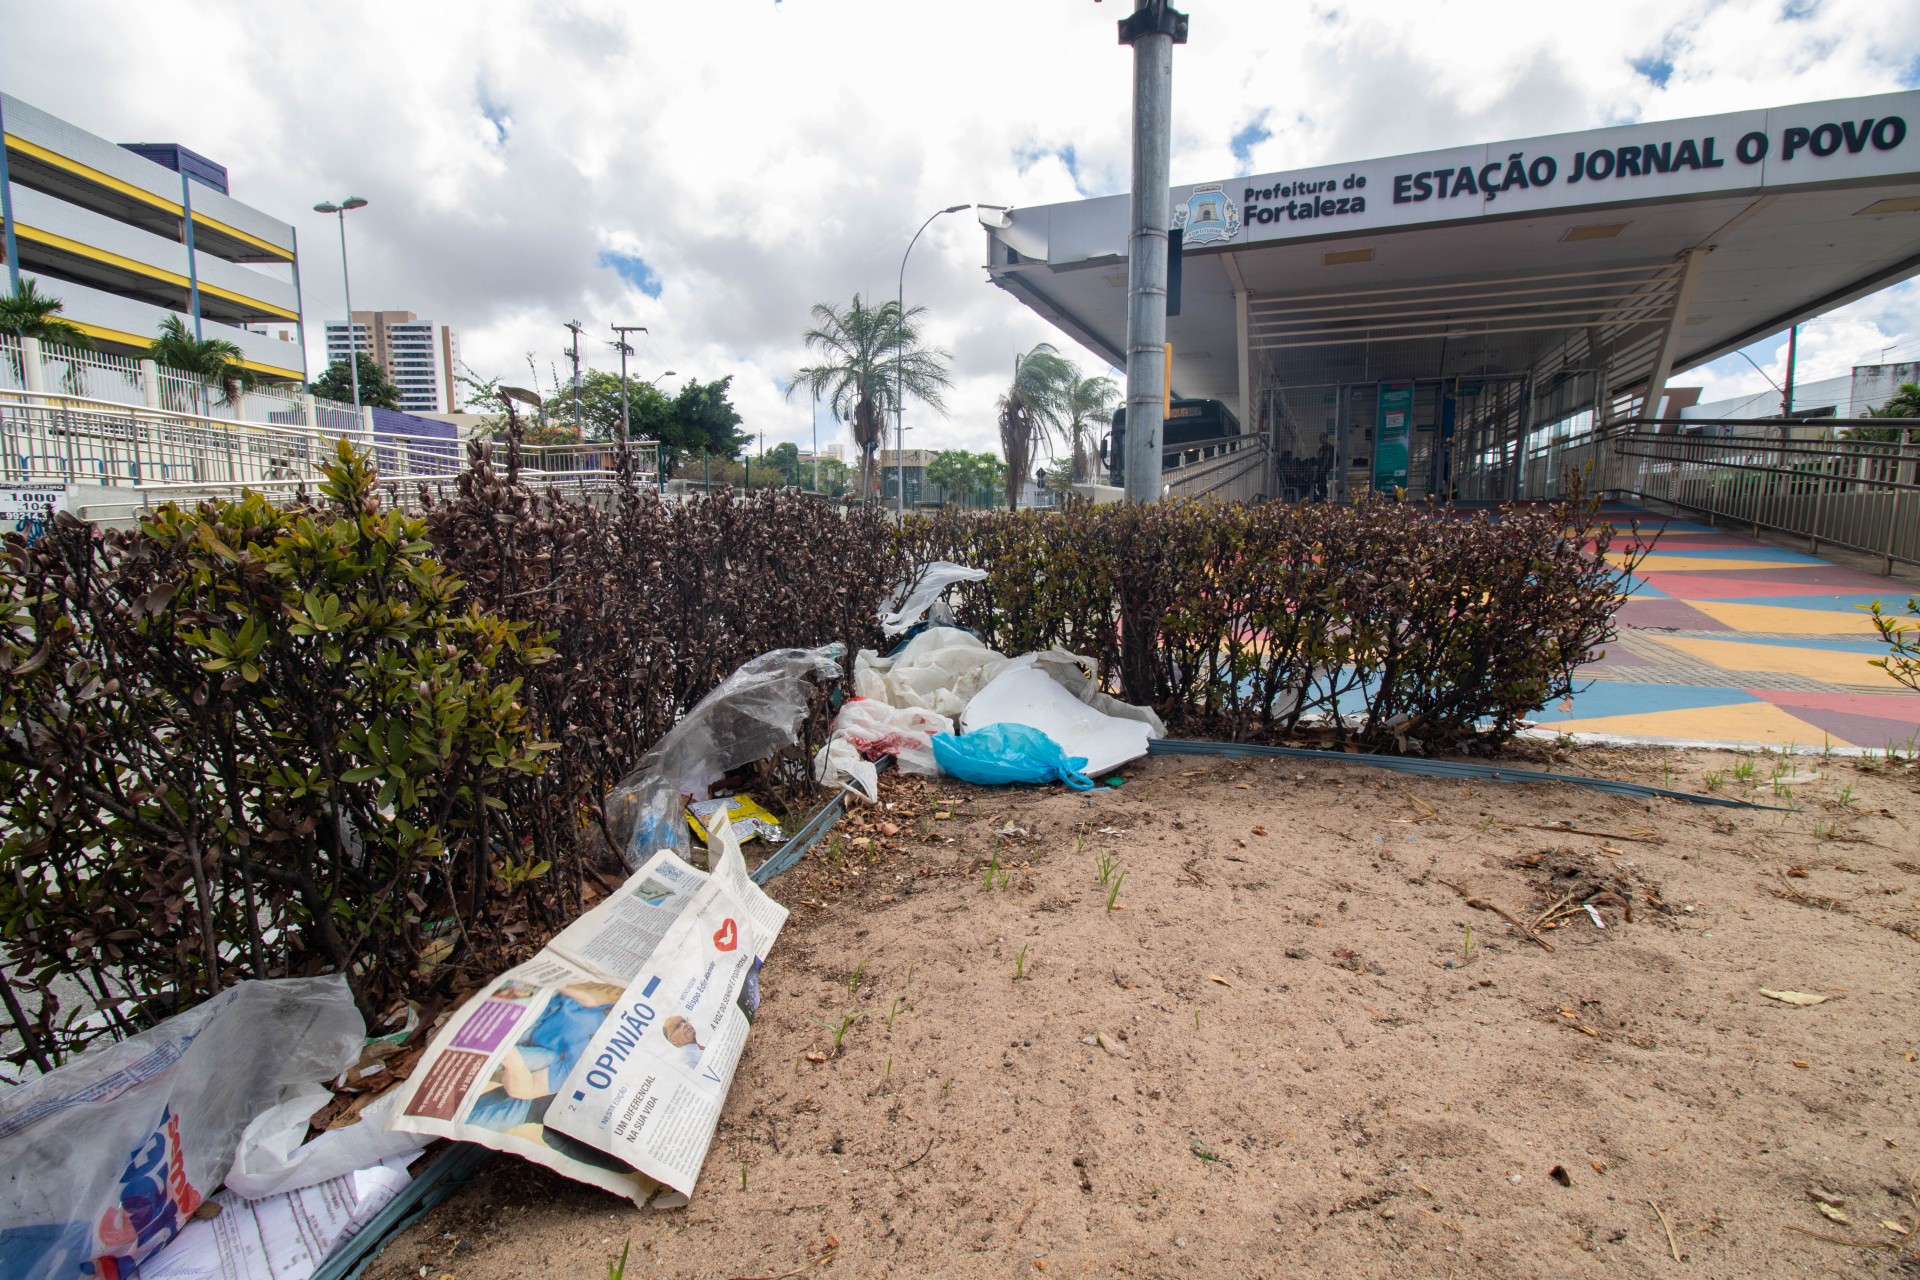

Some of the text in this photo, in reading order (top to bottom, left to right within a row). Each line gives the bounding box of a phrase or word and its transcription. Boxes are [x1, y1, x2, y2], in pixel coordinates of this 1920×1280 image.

[1393, 116, 1907, 203] ESTAÇÃO JORNAL O POVO
[1244, 174, 1367, 202] Prefeitura de
[1243, 196, 1366, 226] Fortaleza
[731, 954, 749, 983] PODEROSA
[680, 977, 697, 1001] MENSAGEM
[685, 992, 701, 1012] Bispo
[697, 979, 707, 993] Edir
[713, 1010, 724, 1025] VOZ
[720, 1002, 727, 1014] DO
[710, 1023, 717, 1031] A
[586, 1002, 656, 1090] OPINIÃO
[601, 1104, 615, 1126] NESTA
[614, 1075, 656, 1136] UM DIFERENCIAL
[626, 1096, 658, 1143] NA SUA VIDA
